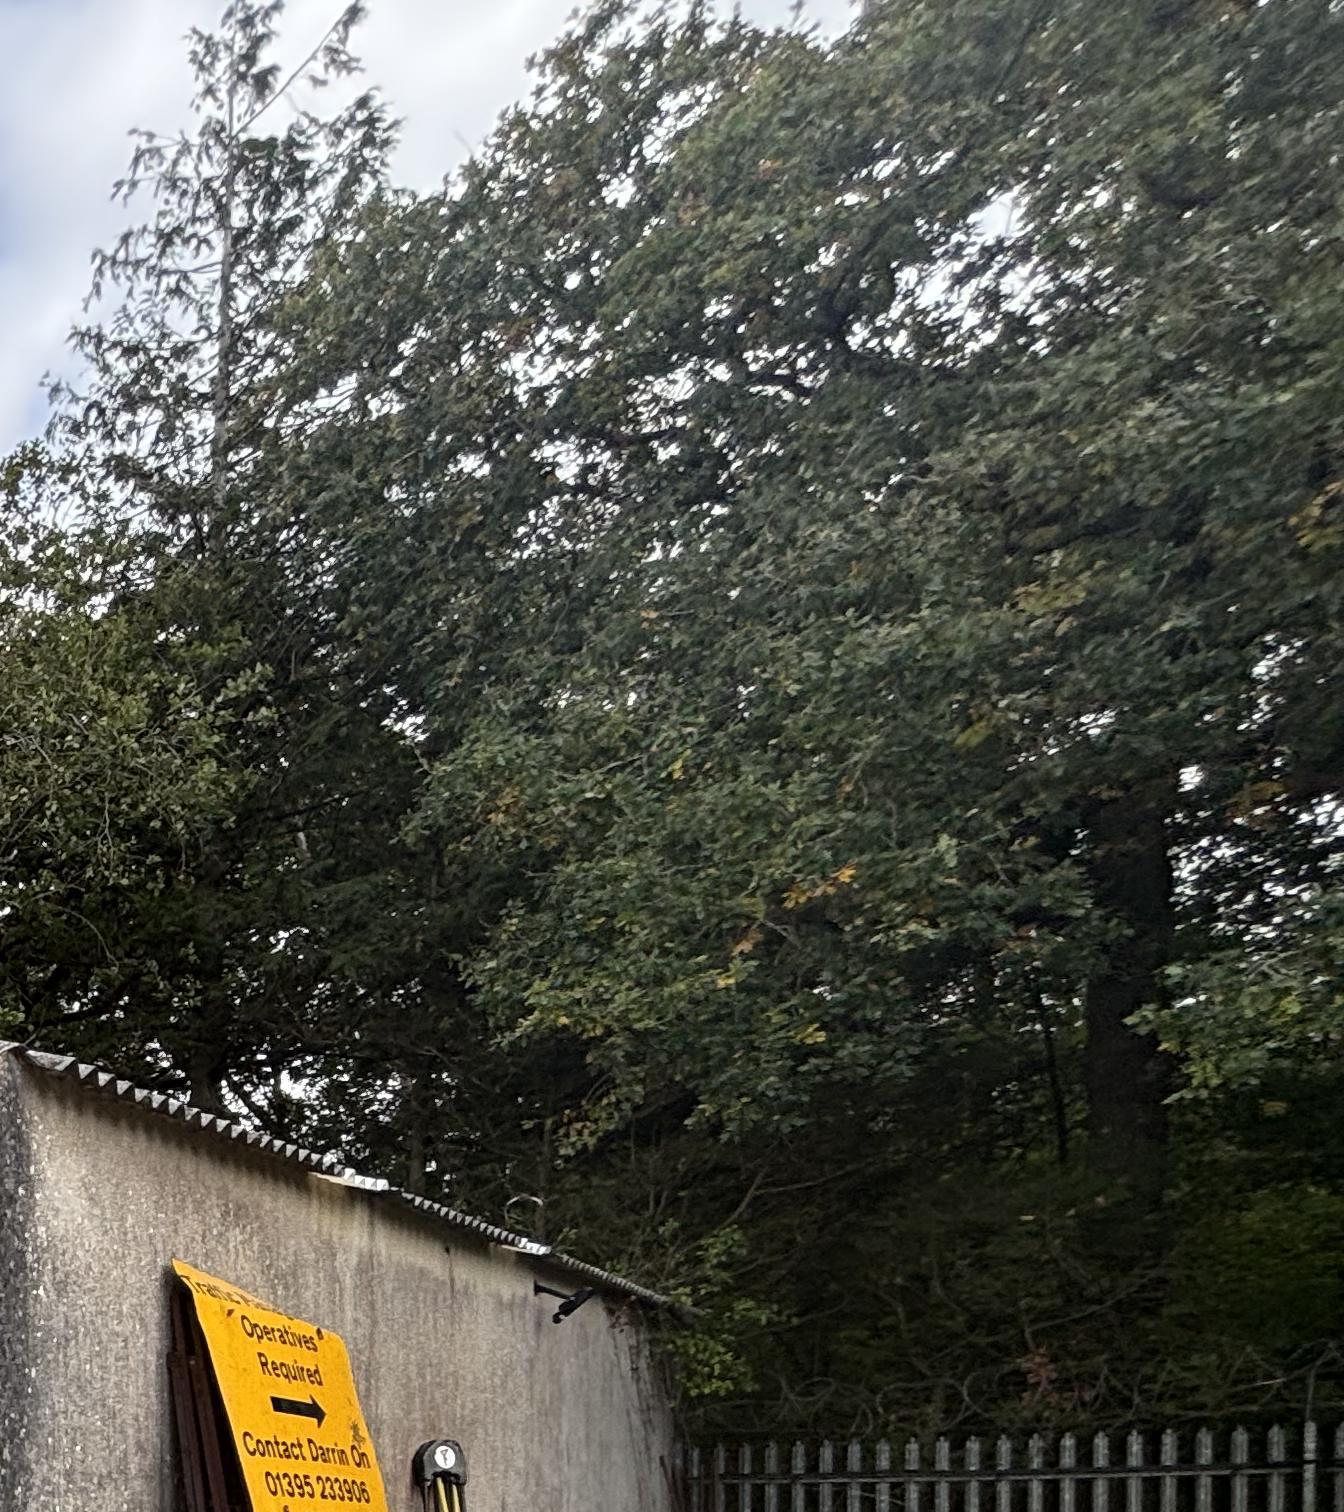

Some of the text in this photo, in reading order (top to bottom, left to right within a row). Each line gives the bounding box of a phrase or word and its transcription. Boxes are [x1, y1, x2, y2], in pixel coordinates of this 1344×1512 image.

[240, 1314, 318, 1352] Operatives
[257, 1352, 323, 1387] Required
[242, 1431, 371, 1469] Contact Darrin On
[264, 1470, 371, 1504] 01395 233906
